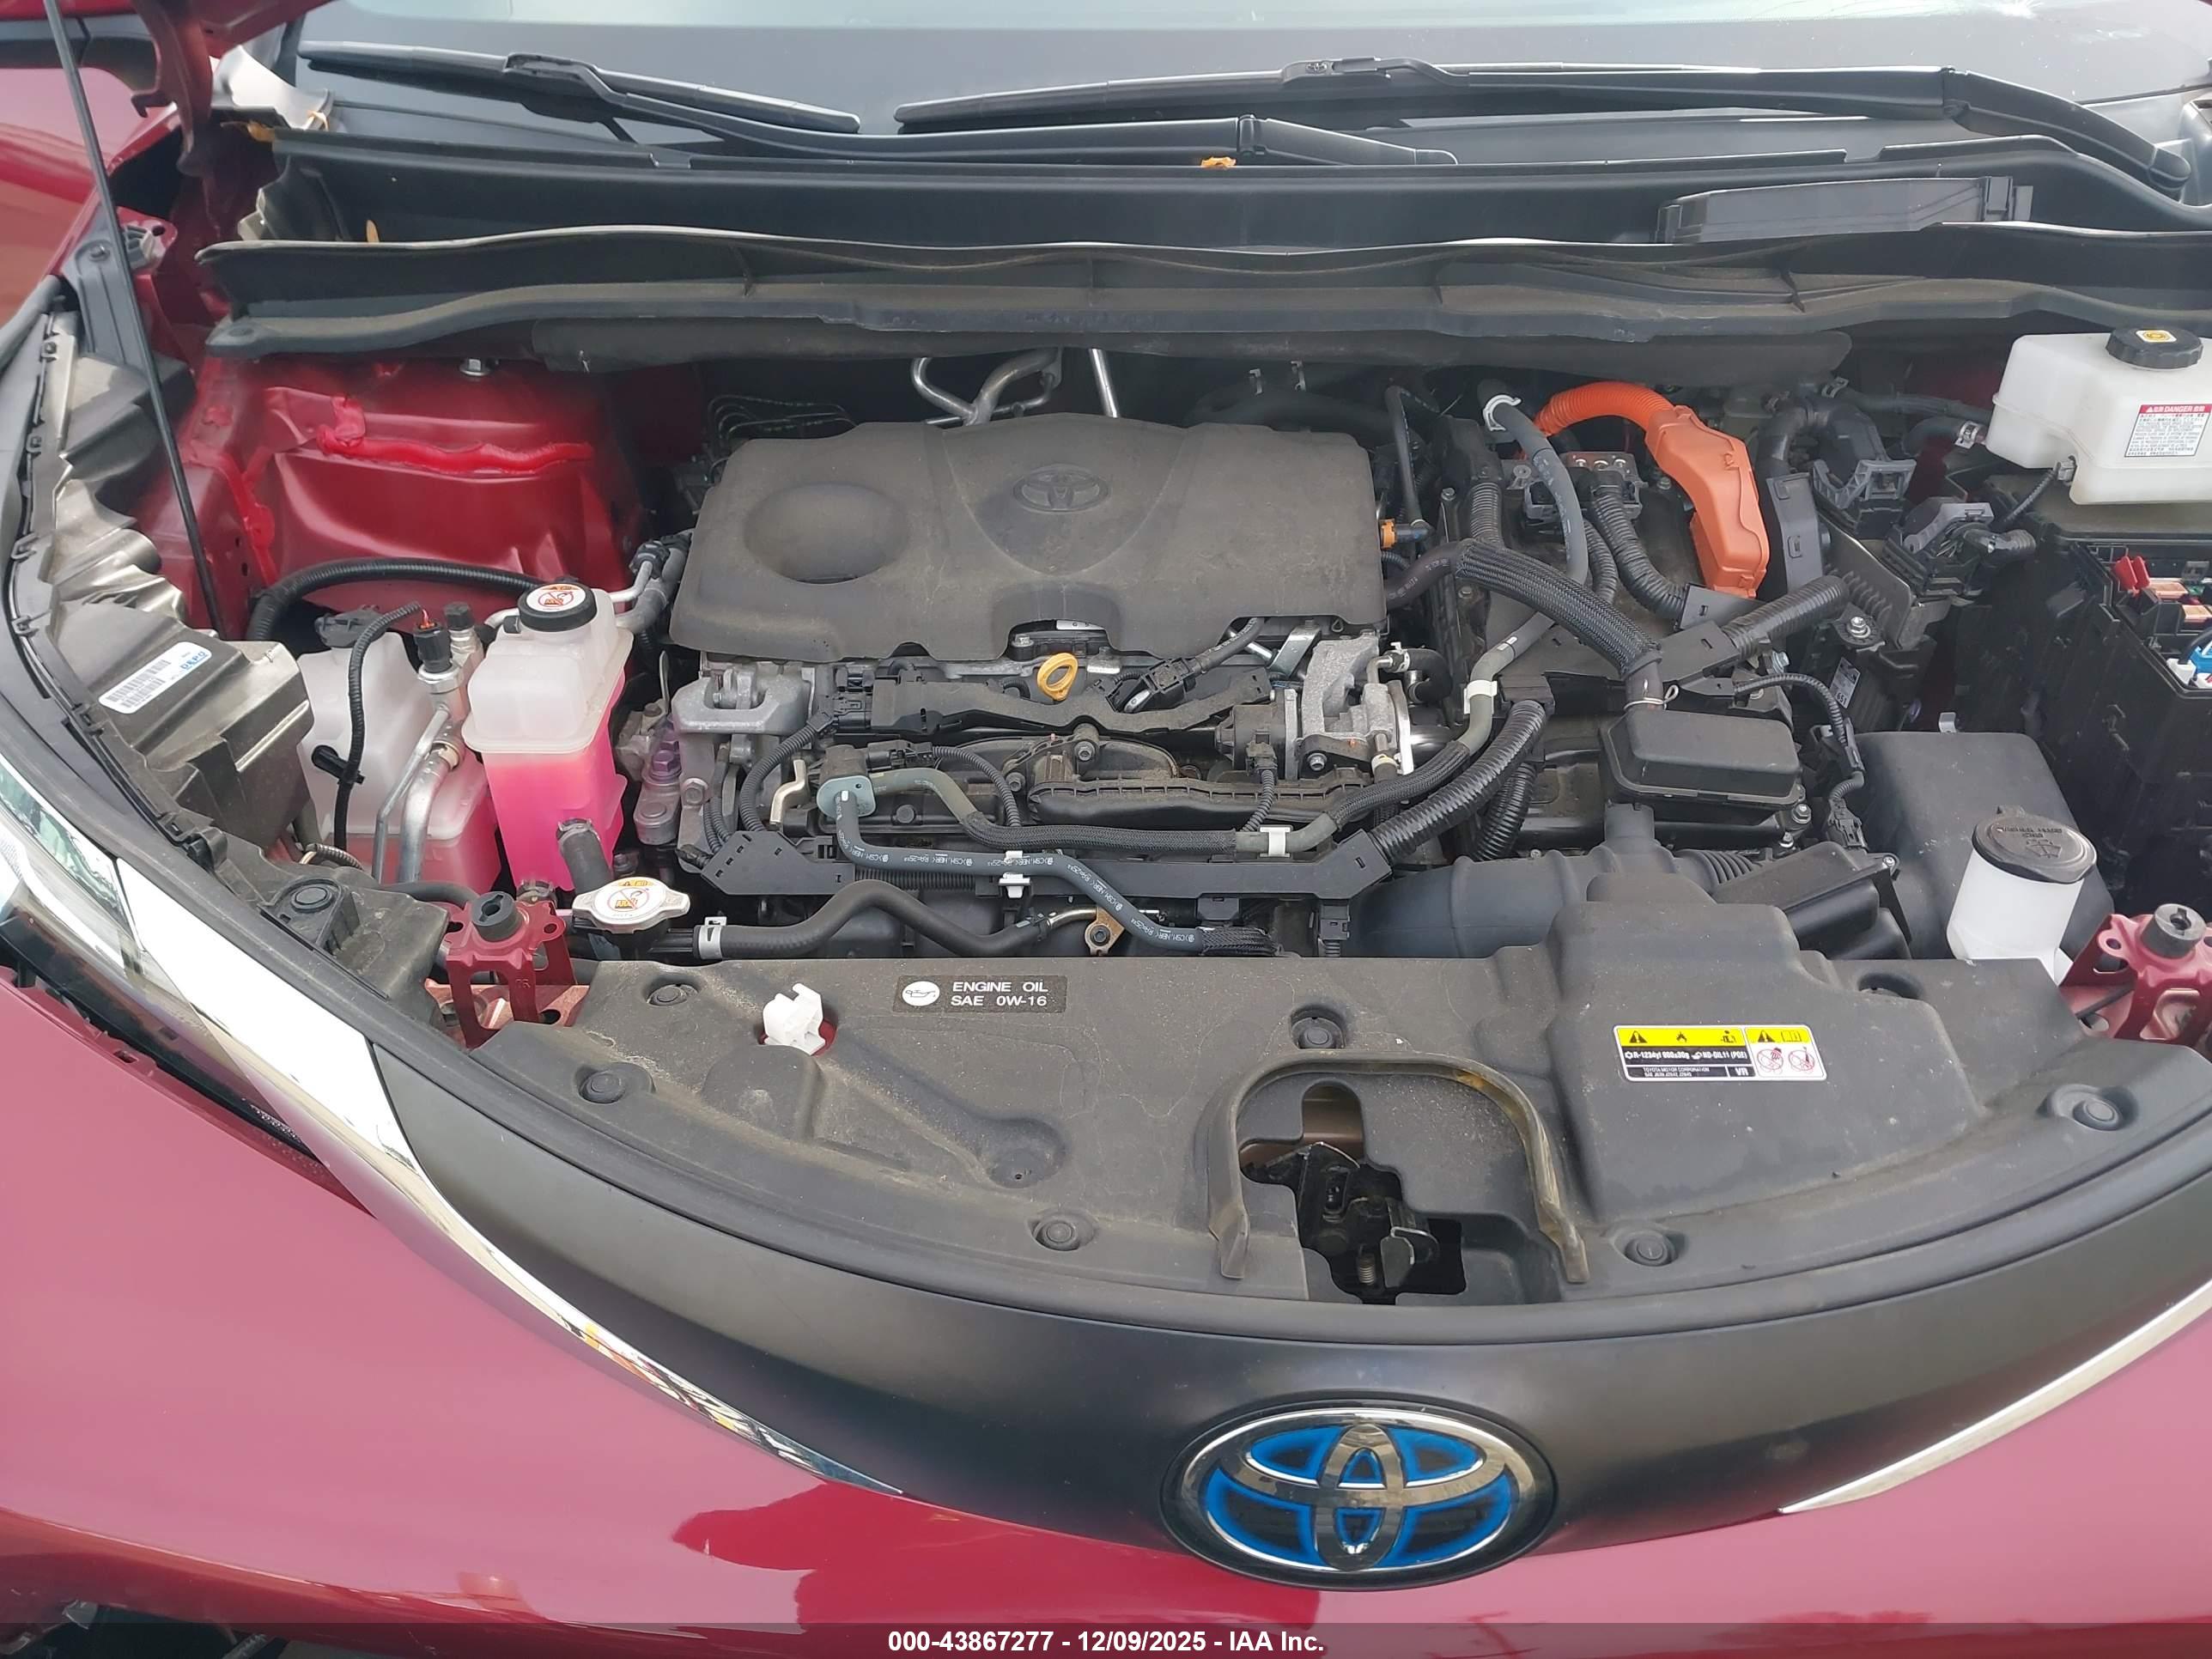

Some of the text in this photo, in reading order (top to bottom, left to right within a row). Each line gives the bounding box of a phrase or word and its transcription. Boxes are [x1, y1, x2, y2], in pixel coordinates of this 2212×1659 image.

[179, 651, 206, 670] DEPO
[1837, 692, 1847, 706] 651
[952, 981, 1048, 992] ENGINE OIL
[951, 995, 1048, 1006] SAE 0W-16
